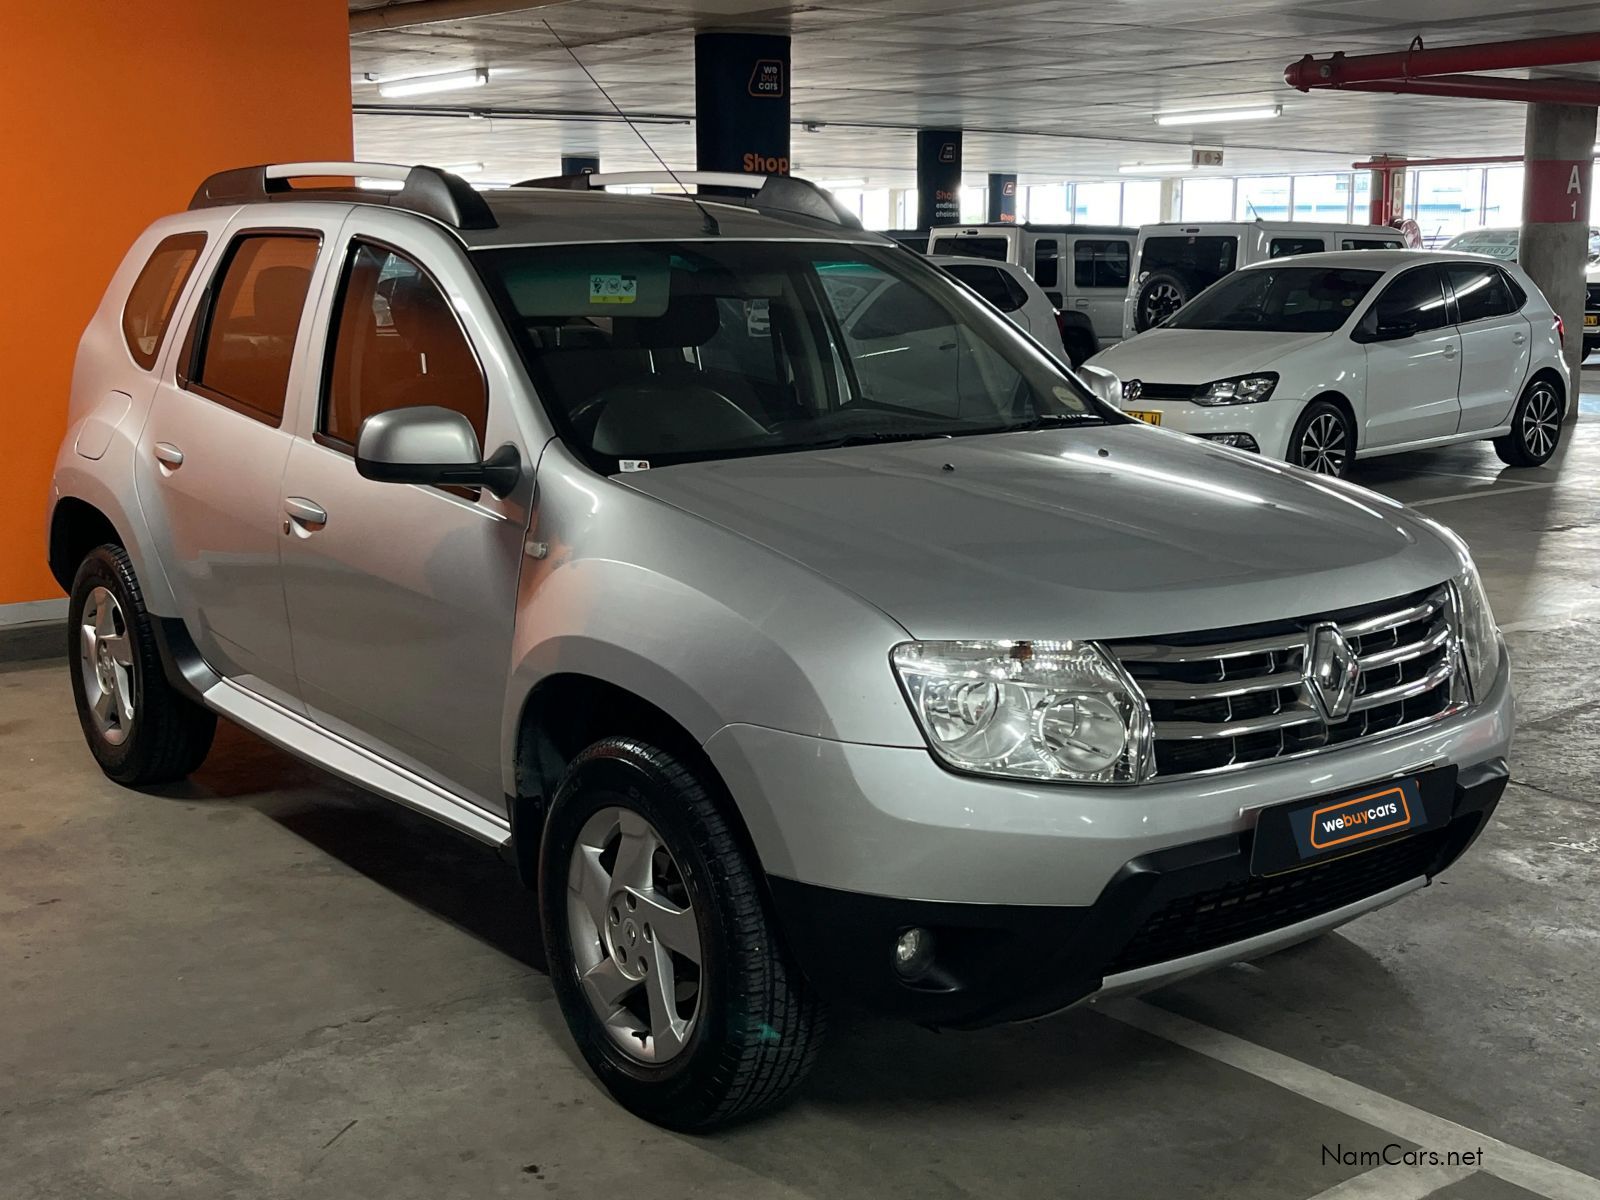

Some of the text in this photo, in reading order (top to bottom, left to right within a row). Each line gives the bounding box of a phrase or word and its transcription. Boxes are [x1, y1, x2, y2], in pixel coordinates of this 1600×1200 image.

[761, 73, 778, 83] buy
[764, 66, 778, 74] we
[758, 82, 778, 90] cars
[743, 153, 788, 175] Shop
[1566, 165, 1581, 194] A
[1571, 200, 1577, 220] 1
[1322, 802, 1398, 833] webuycars
